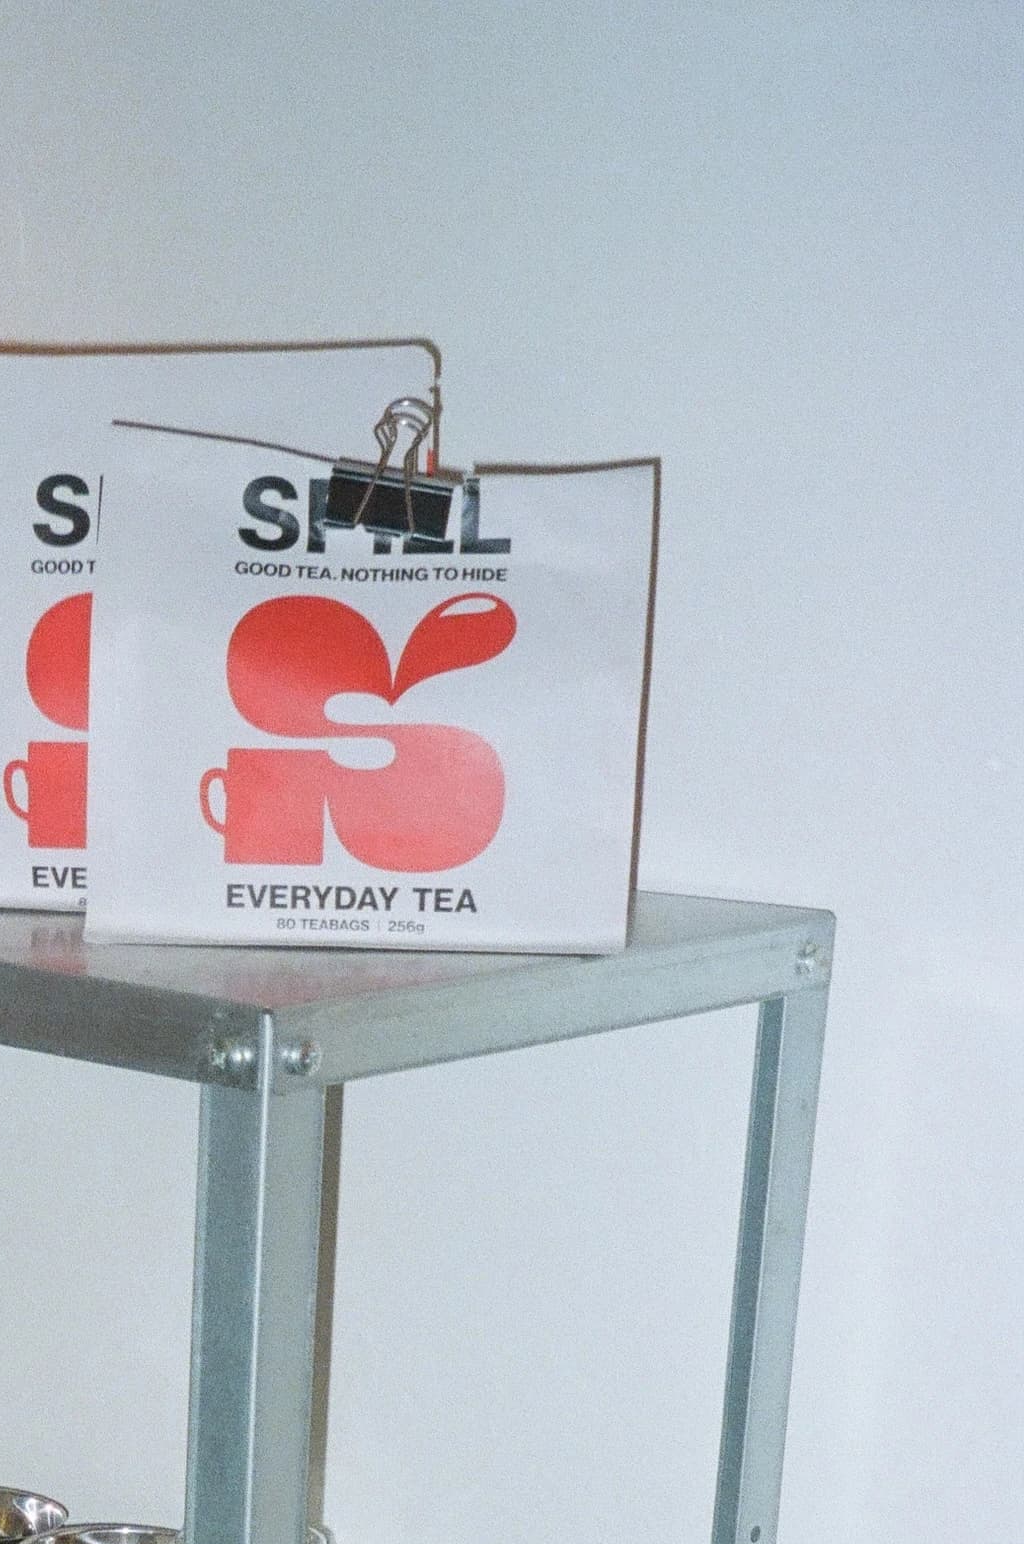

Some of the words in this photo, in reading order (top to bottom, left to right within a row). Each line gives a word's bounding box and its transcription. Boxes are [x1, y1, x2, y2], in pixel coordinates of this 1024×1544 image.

[32, 474, 104, 547] S
[31, 559, 84, 575] GOOD
[235, 561, 291, 578] GOOD
[295, 565, 337, 581] TEA.
[340, 567, 429, 582] NOTHING
[432, 567, 459, 581] TO
[461, 567, 508, 582] HIDE
[32, 866, 88, 889] EVE
[225, 883, 399, 911] EVERYDAY
[412, 887, 478, 913] TEA
[276, 917, 296, 930] 80
[300, 918, 370, 932] TEABAGS
[387, 920, 426, 935] 256g
